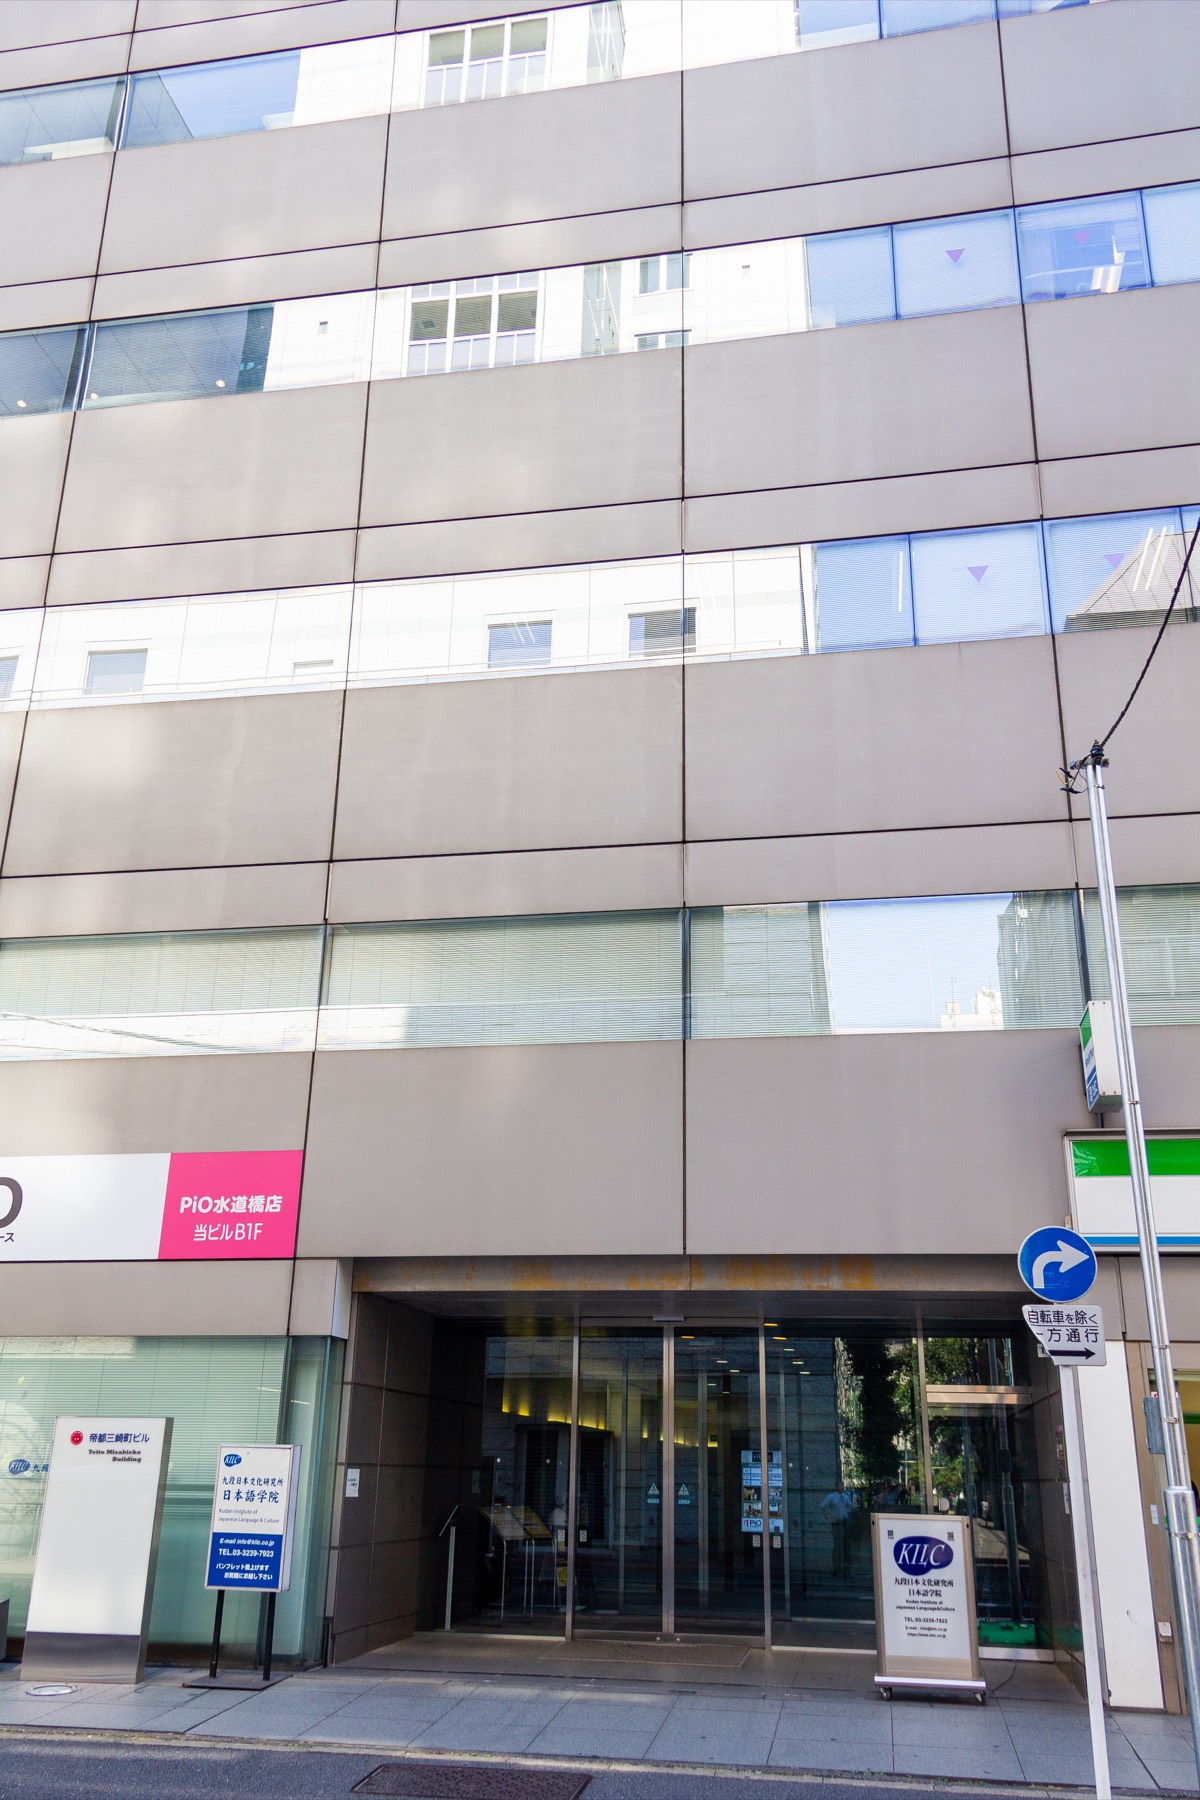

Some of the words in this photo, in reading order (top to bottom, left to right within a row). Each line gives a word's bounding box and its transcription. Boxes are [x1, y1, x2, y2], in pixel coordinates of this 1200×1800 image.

[180, 1195, 283, 1214] PiO水道橋店
[193, 1223, 263, 1241] 当ビルB1F
[1027, 1310, 1098, 1325] 自転車を除く
[89, 1433, 150, 1443] 帝都三崎町ビル
[222, 1476, 284, 1487] 九段日本文化研究所
[223, 1489, 279, 1503] 日本語学院
[219, 1548, 274, 1558] TEL.03-3239-7923
[897, 1543, 946, 1567] KILC
[894, 1577, 954, 1587] 九段日本文化研究所
[908, 1588, 942, 1597] 日本語学院
